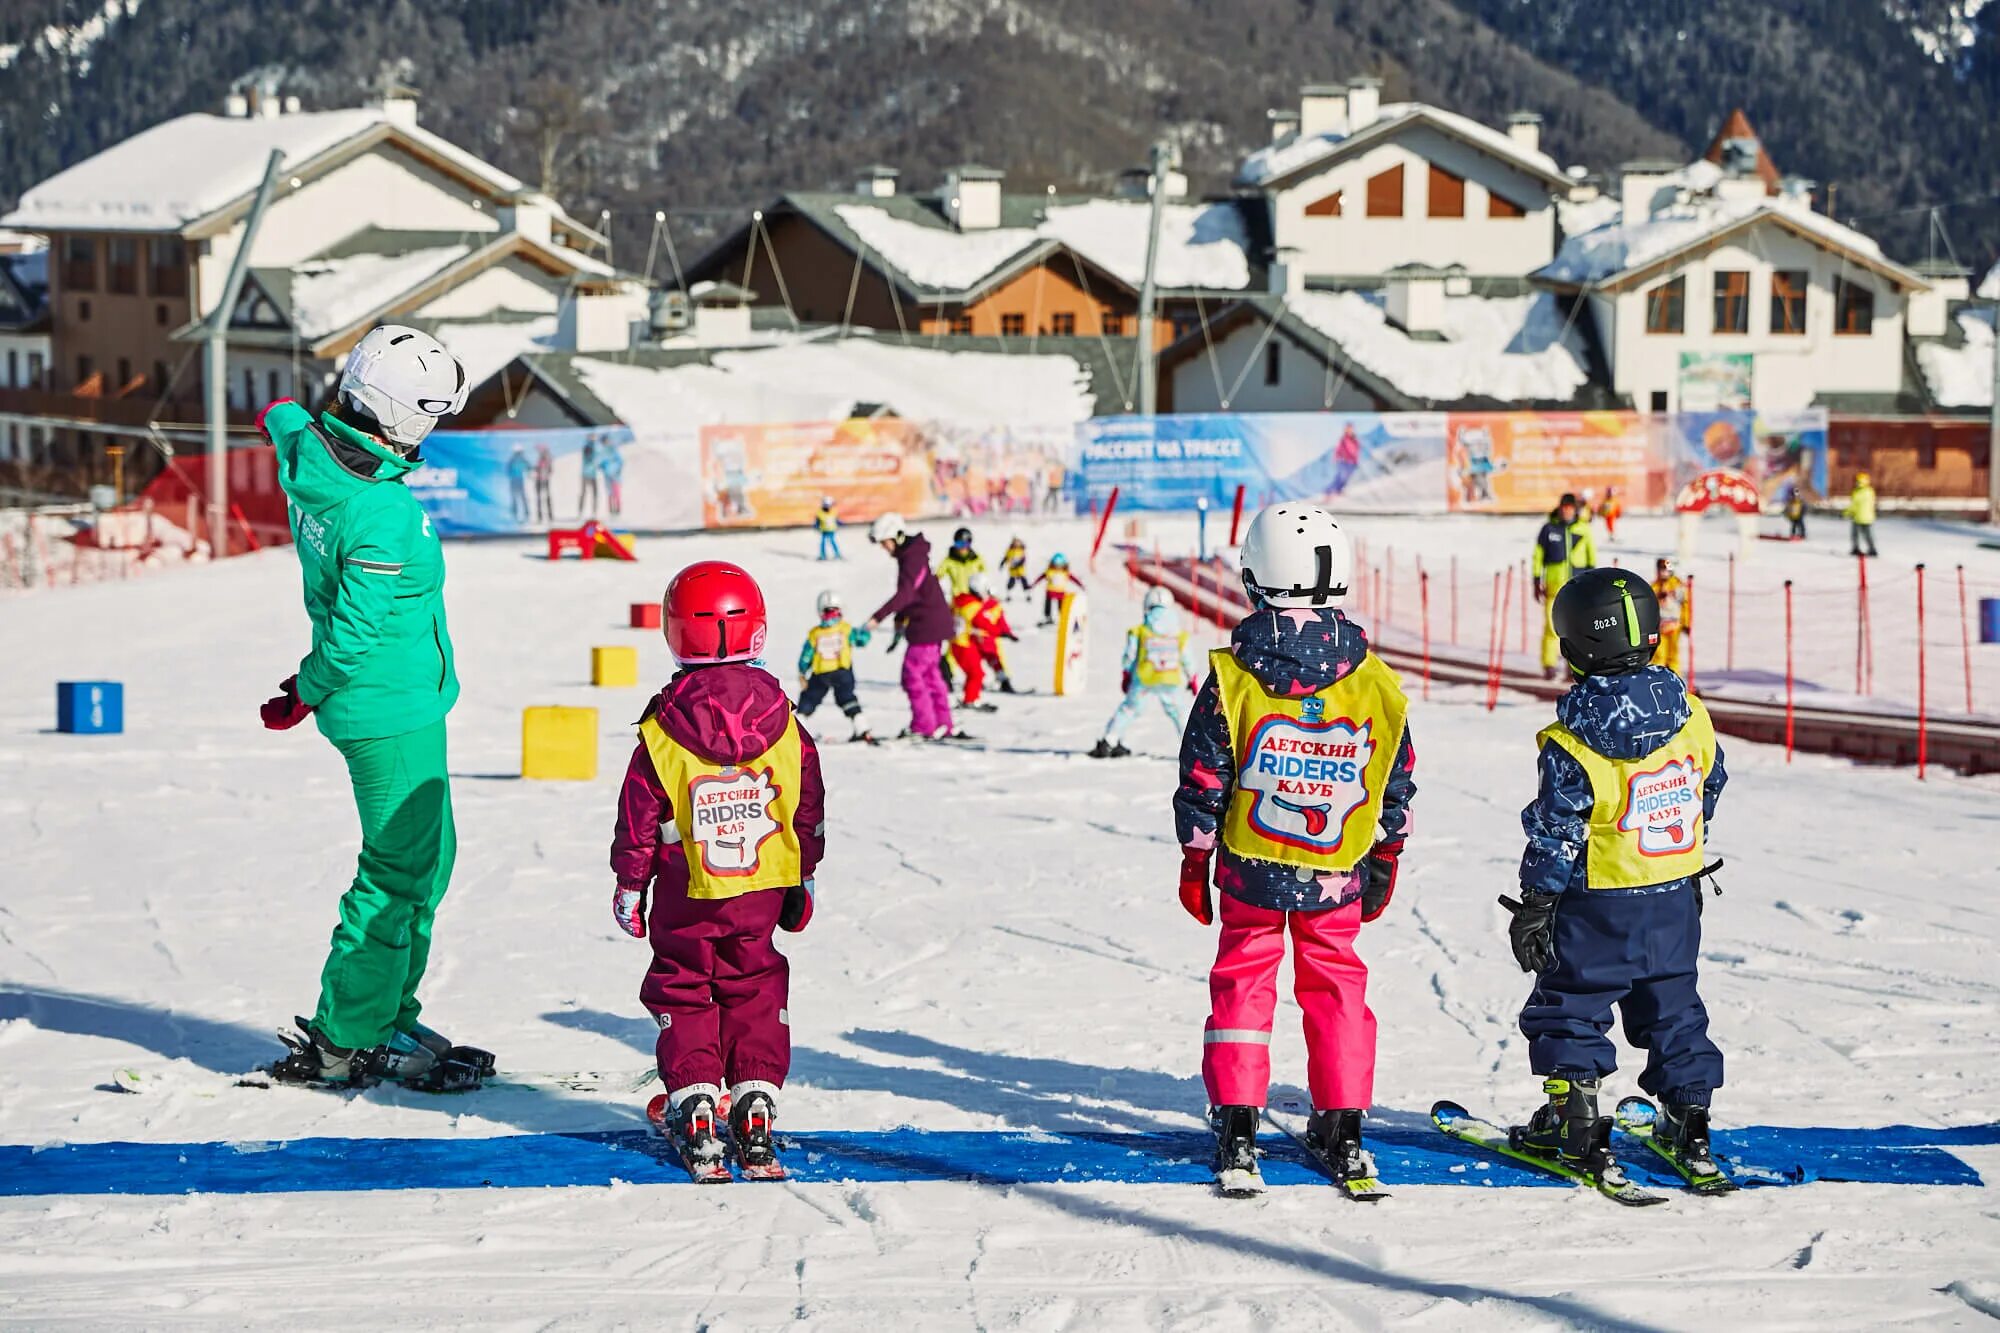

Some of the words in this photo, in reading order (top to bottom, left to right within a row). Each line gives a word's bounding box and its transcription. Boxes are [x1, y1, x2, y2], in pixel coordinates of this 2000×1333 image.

[1261, 737, 1358, 758] ДЕТСКИЙ
[1259, 753, 1357, 782] RIDERS
[1277, 779, 1333, 797] КЛУБ
[1637, 788, 1692, 814] RIDERS
[1649, 806, 1681, 822] КЛУБ
